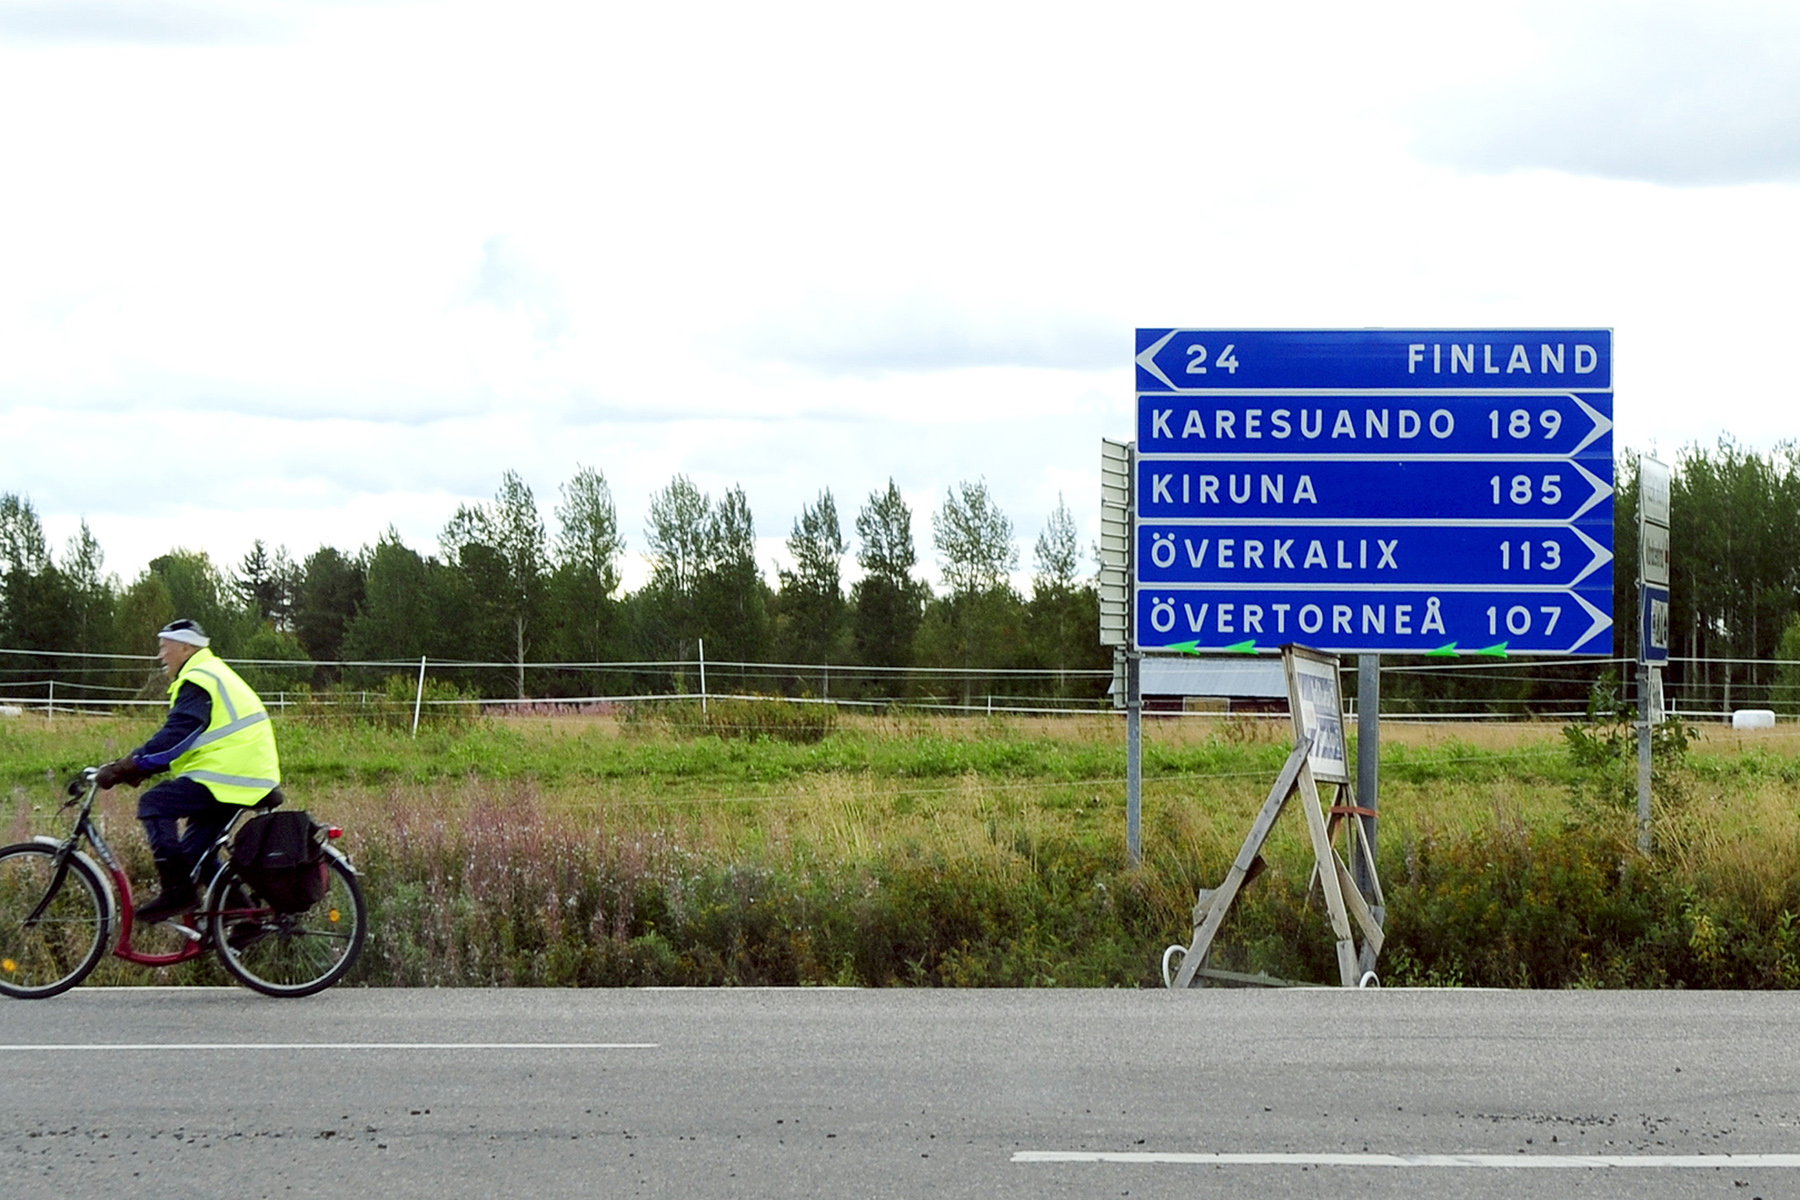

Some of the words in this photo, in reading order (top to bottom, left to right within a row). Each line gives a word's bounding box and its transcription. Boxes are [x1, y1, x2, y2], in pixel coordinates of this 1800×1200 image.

[1186, 344, 1239, 374] 24
[1408, 344, 1598, 374] FINLAND
[1152, 409, 1455, 439] KARESUANDO
[1489, 409, 1562, 439] 189
[1152, 474, 1318, 504] KIRUNA
[1490, 475, 1563, 505] 185
[1151, 532, 1399, 569] ÖVERKALIX
[1500, 541, 1562, 570] 113
[1151, 597, 1446, 634] ÖVERTORNEÅ
[1486, 606, 1562, 635] 107
